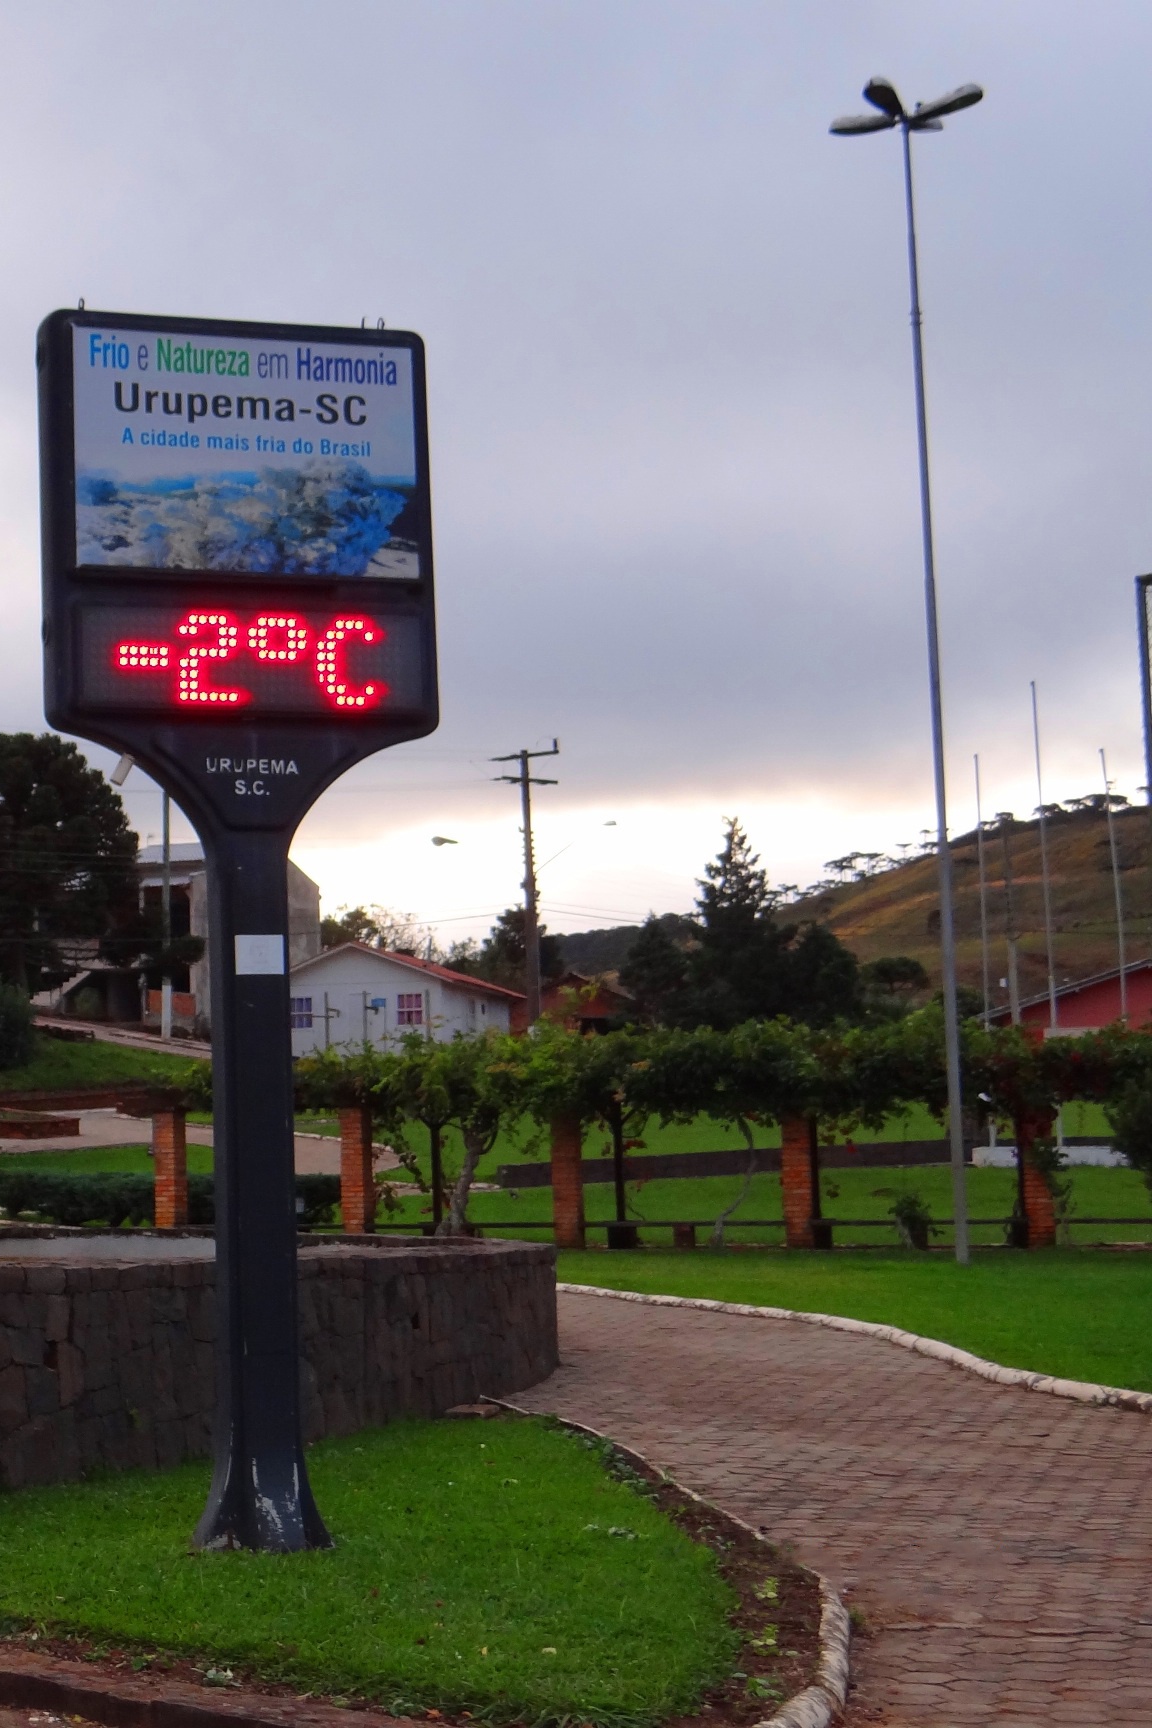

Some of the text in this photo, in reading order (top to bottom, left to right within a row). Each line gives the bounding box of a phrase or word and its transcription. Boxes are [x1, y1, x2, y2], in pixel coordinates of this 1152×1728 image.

[89, 334, 398, 387] Frio e Natureza em Harmonia
[113, 381, 367, 426] Urupema-SC
[122, 427, 371, 458] A cidade mais fria do Brasil
[206, 756, 299, 776] URUPEMA
[234, 780, 271, 796] S.C.
